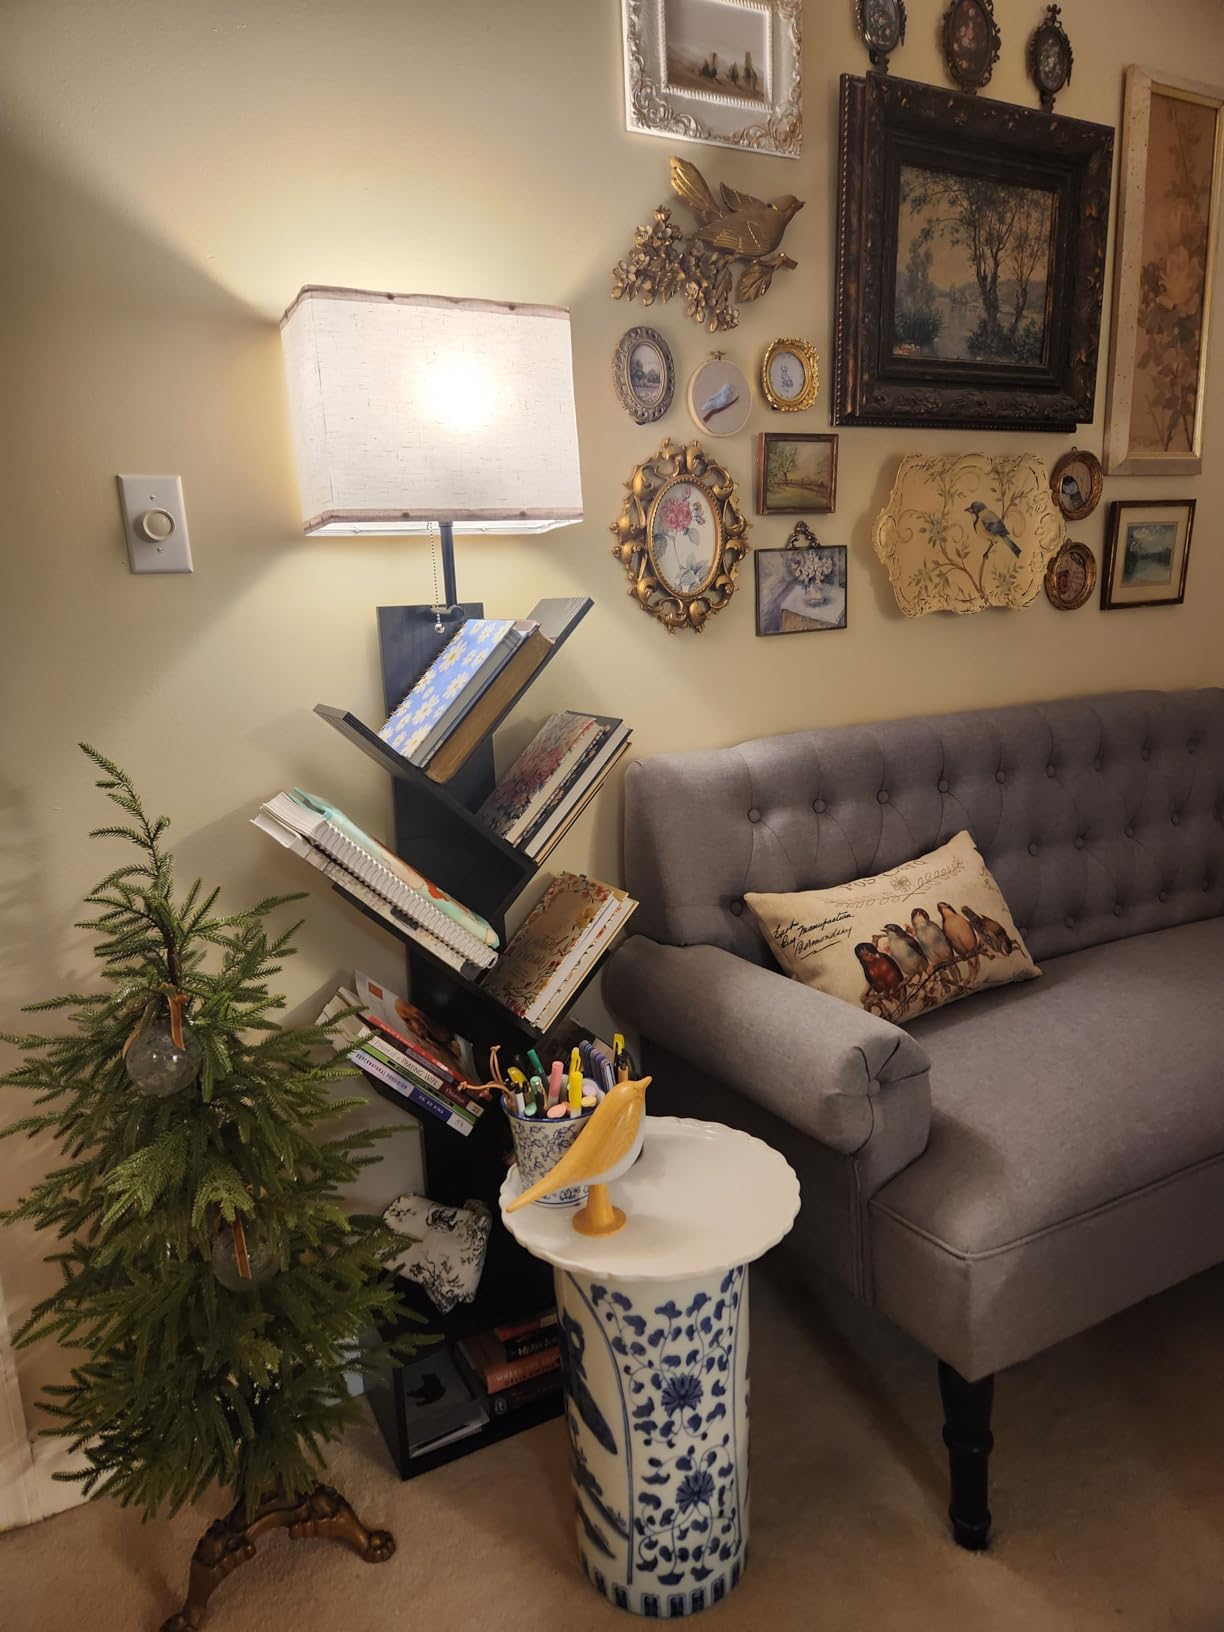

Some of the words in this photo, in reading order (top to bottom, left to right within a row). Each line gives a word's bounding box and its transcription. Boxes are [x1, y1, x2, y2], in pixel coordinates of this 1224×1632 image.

[355, 1053, 387, 1076] SUPERNATURAL
[402, 1057, 424, 1077] PRAYING
[424, 1073, 438, 1087] WIFE
